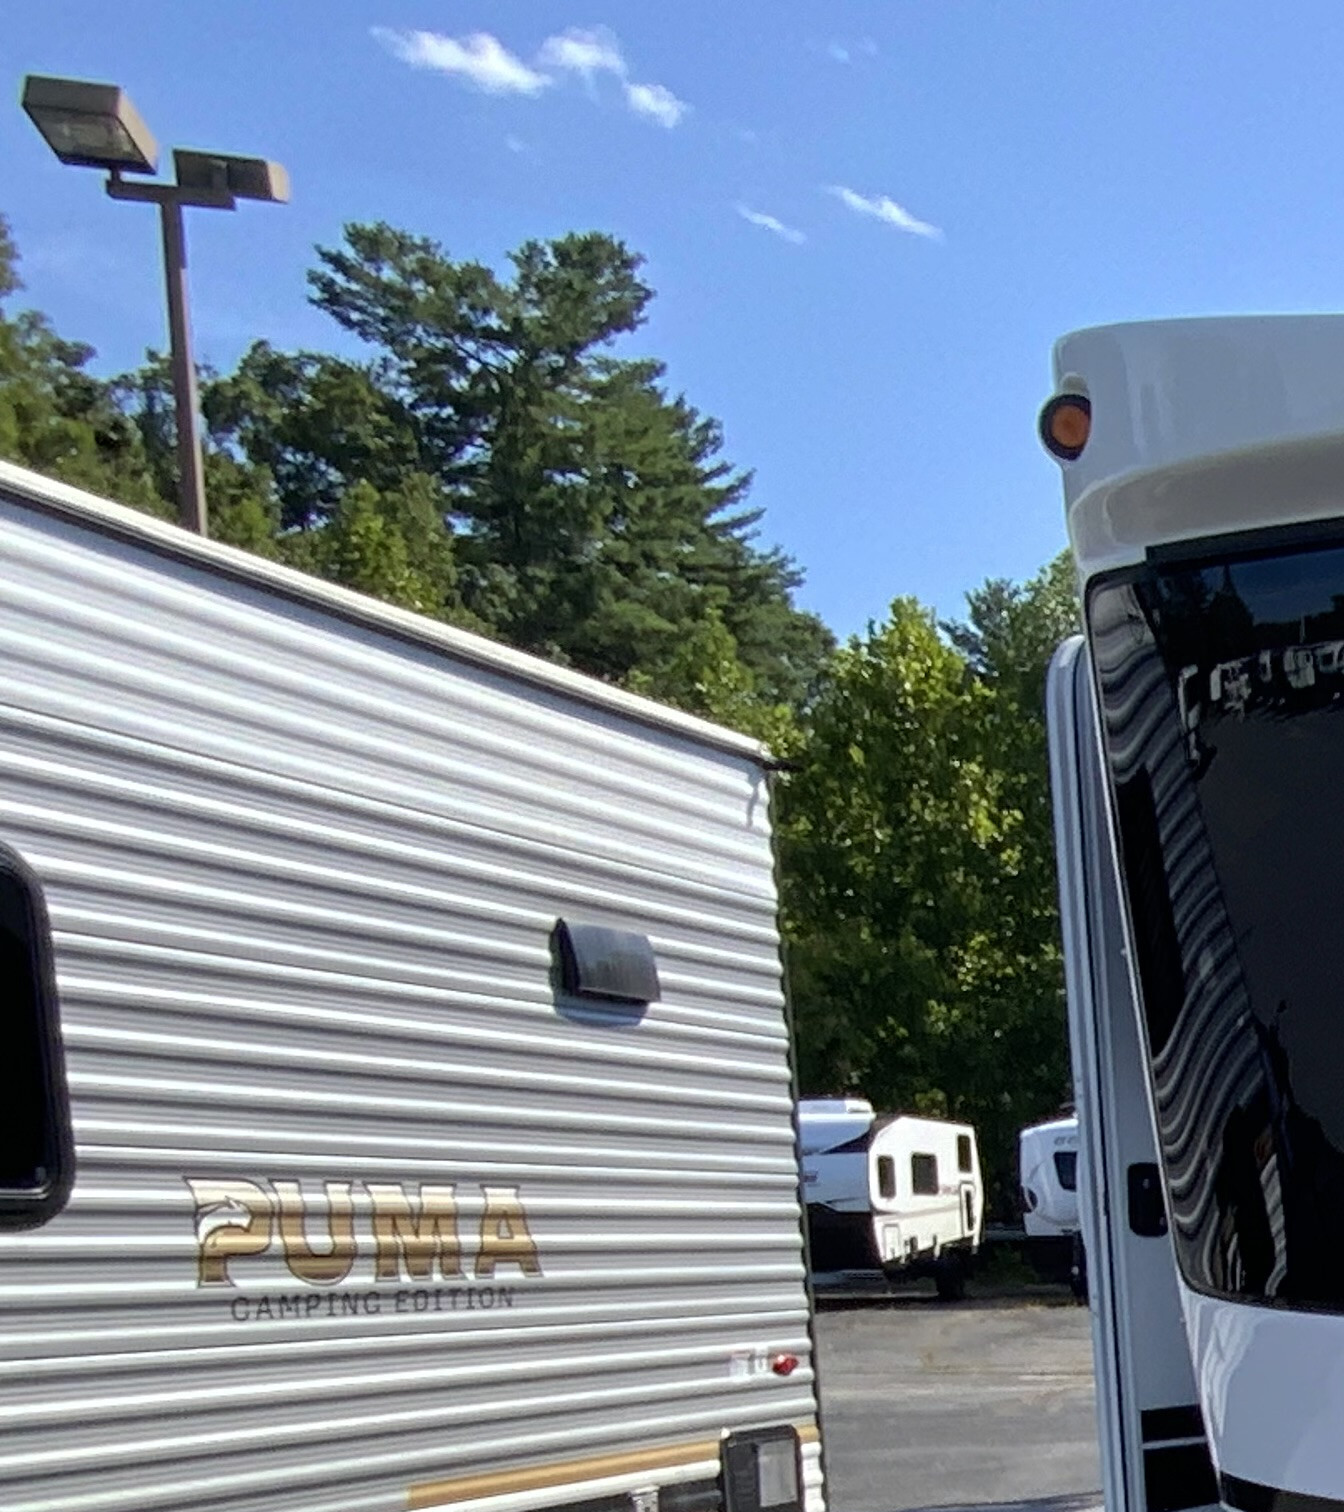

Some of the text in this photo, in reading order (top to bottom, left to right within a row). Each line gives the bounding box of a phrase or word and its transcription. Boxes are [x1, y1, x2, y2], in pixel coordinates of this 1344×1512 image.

[183, 1175, 545, 1289] PUMA
[230, 1286, 515, 1323] CAMPING EDITION
